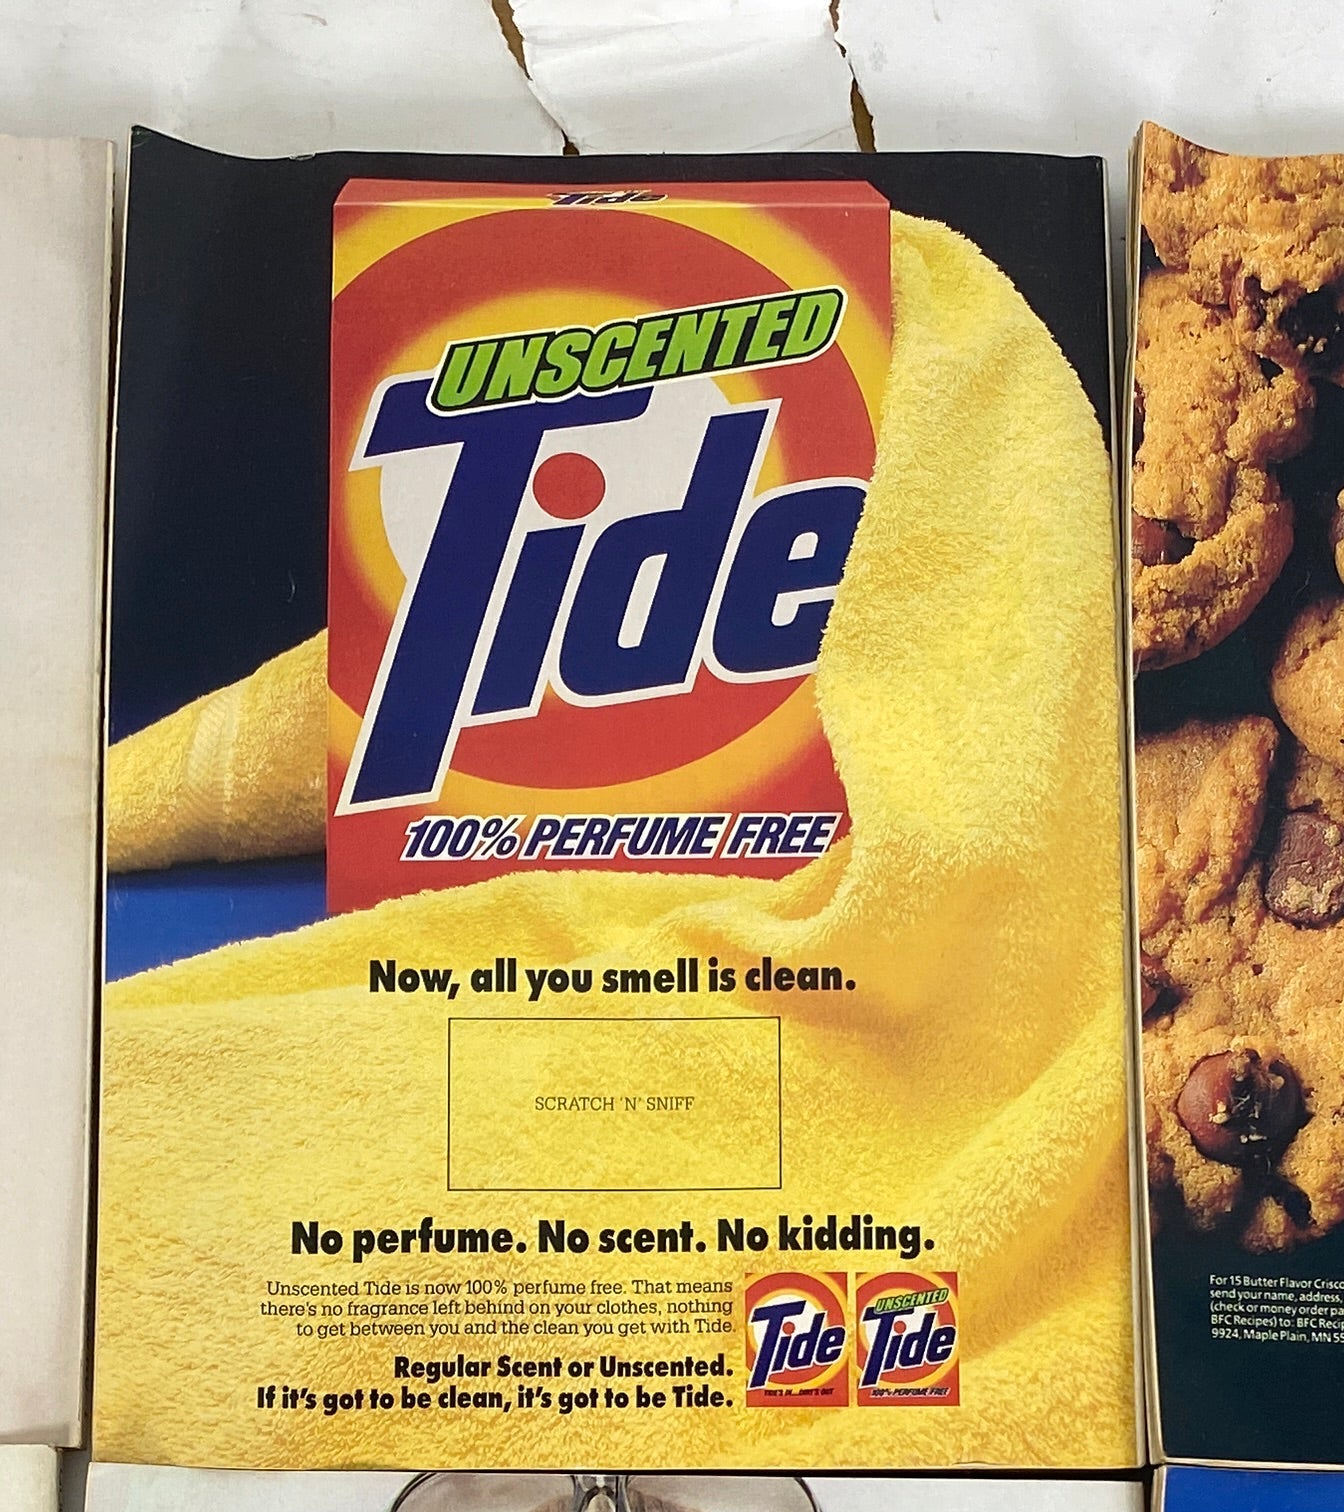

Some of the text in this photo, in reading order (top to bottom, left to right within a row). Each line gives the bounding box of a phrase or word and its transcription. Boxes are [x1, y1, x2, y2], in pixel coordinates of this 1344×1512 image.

[436, 289, 839, 403] UNSCENTED
[349, 378, 869, 806] Tide
[404, 813, 840, 860] 100% PERFUME FREE
[370, 956, 856, 1002] Now, all you smell is clean.
[535, 1096, 615, 1111] SCRATCH
[647, 1096, 695, 1111] SNIFF
[874, 1288, 949, 1313] UNSCENTED
[1210, 1275, 1228, 1285] For
[1230, 1275, 1242, 1286] 15
[1243, 1276, 1278, 1287] Butter
[1280, 1277, 1312, 1288] Flavor
[749, 1299, 846, 1388] Tide
[860, 1306, 956, 1387] Tide
